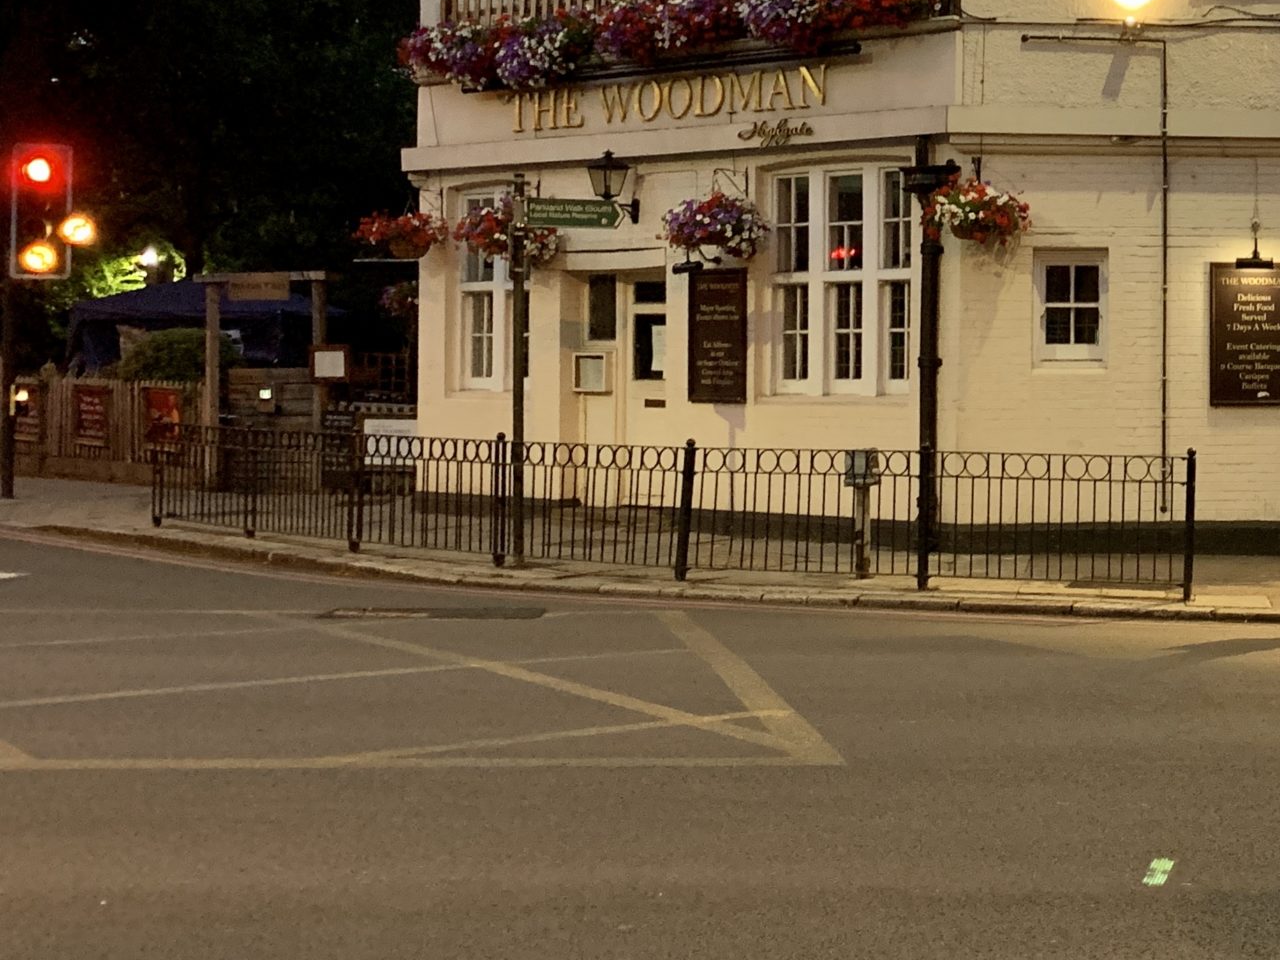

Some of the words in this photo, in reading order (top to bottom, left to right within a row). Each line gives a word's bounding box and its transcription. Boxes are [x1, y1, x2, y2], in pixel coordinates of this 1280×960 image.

[507, 87, 585, 132] THE
[600, 64, 828, 123] WOODMAN
[738, 118, 815, 147] Highgate
[565, 203, 583, 212] Walk
[1221, 277, 1239, 285] THE
[1237, 293, 1272, 302] Delicious
[1233, 303, 1255, 312] Fresh
[1256, 303, 1275, 312] Food
[1241, 313, 1267, 321] Served
[1232, 323, 1251, 333] Days
[1252, 323, 1260, 331] A
[1226, 342, 1249, 351] Event
[1226, 362, 1253, 370] Course
